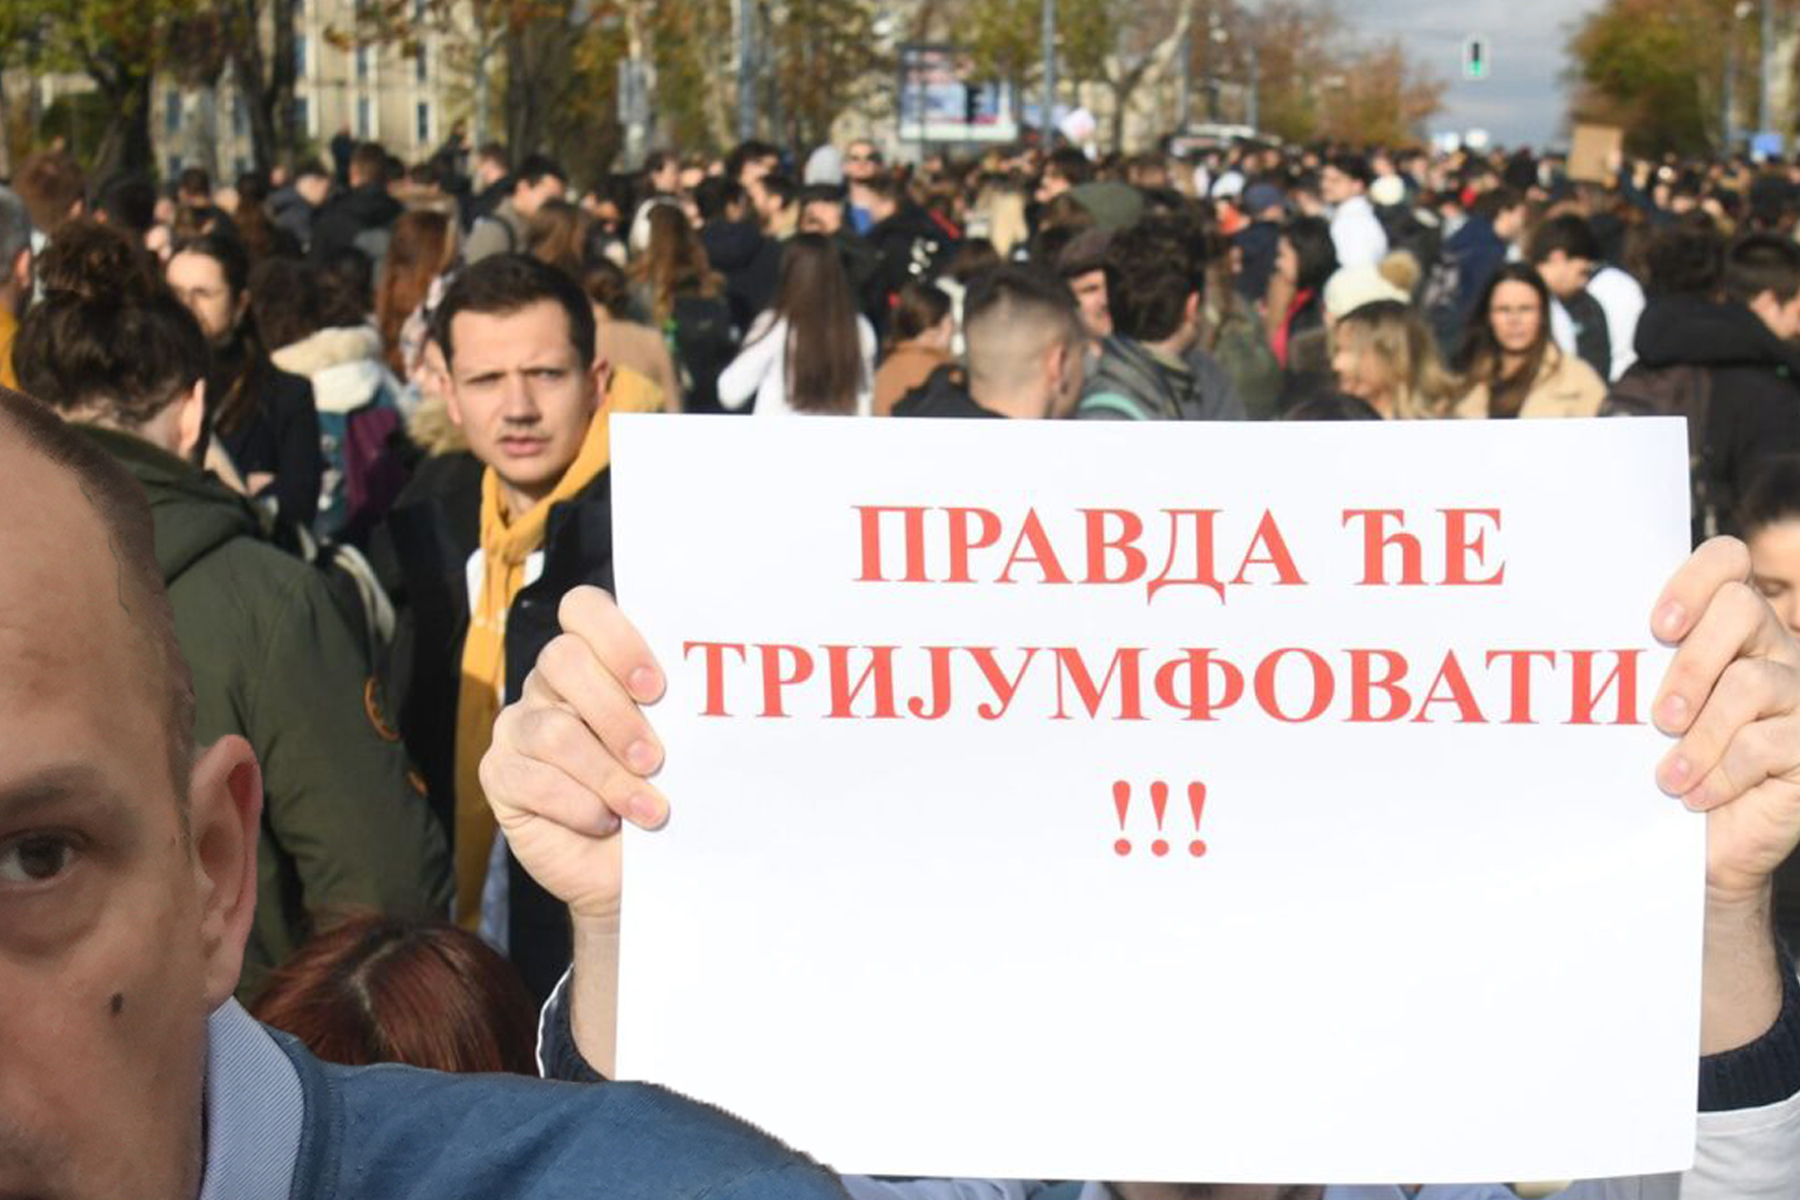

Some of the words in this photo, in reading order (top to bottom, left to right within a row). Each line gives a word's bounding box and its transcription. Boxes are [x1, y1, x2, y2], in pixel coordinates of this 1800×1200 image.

[852, 505, 1307, 603] ПРАВДА
[1341, 506, 1506, 587] ЋЕ
[684, 641, 1646, 725] ТРИЈУМФОВАТИ
[1111, 780, 1208, 857] !!!
